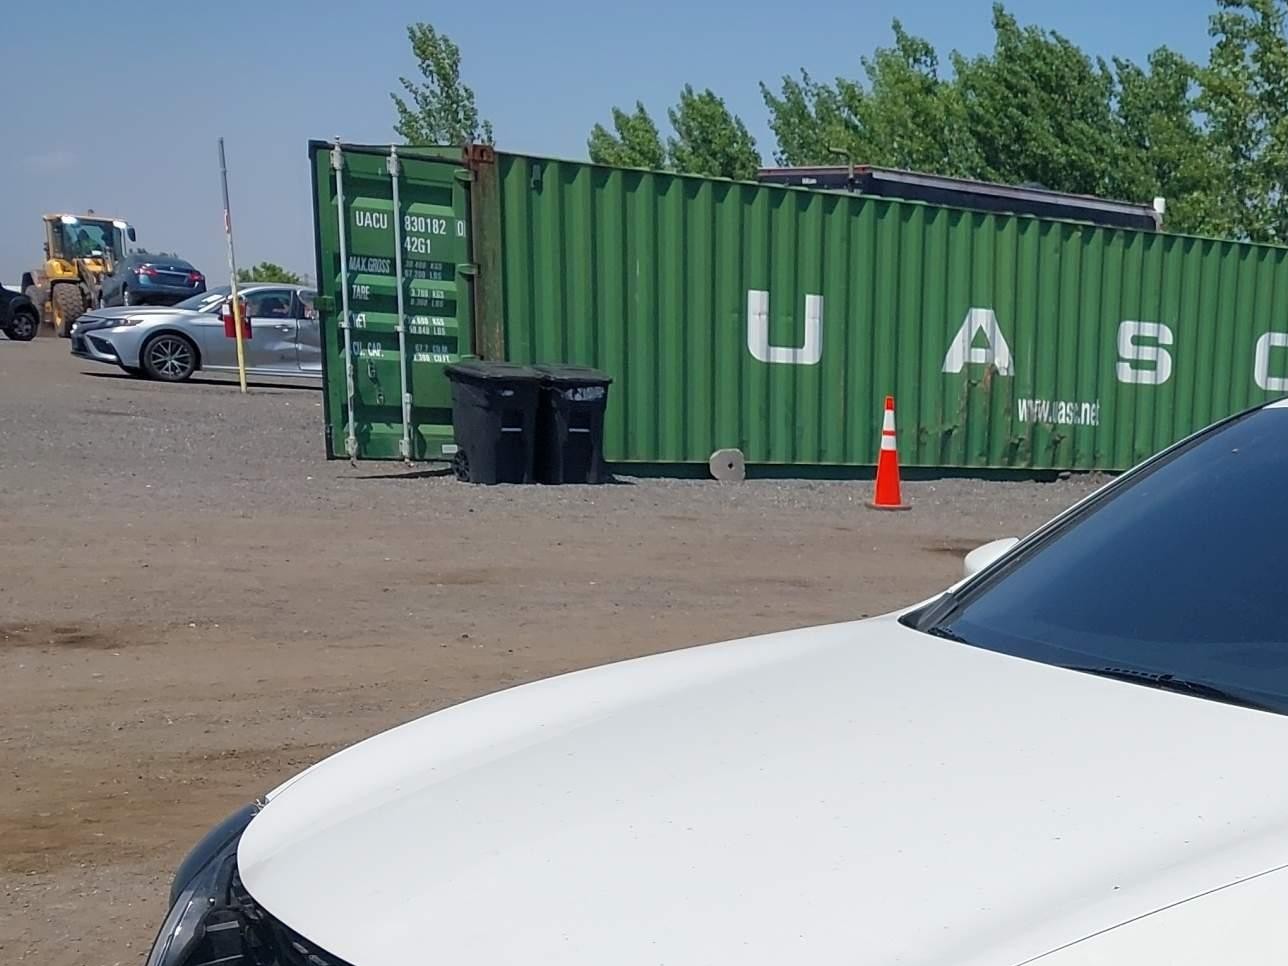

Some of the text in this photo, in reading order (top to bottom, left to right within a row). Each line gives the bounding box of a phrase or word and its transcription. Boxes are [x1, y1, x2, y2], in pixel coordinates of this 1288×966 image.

[355, 210, 388, 229] UACU
[404, 215, 447, 235] 830182
[404, 236, 431, 254] 42G1
[352, 285, 371, 300] TARE
